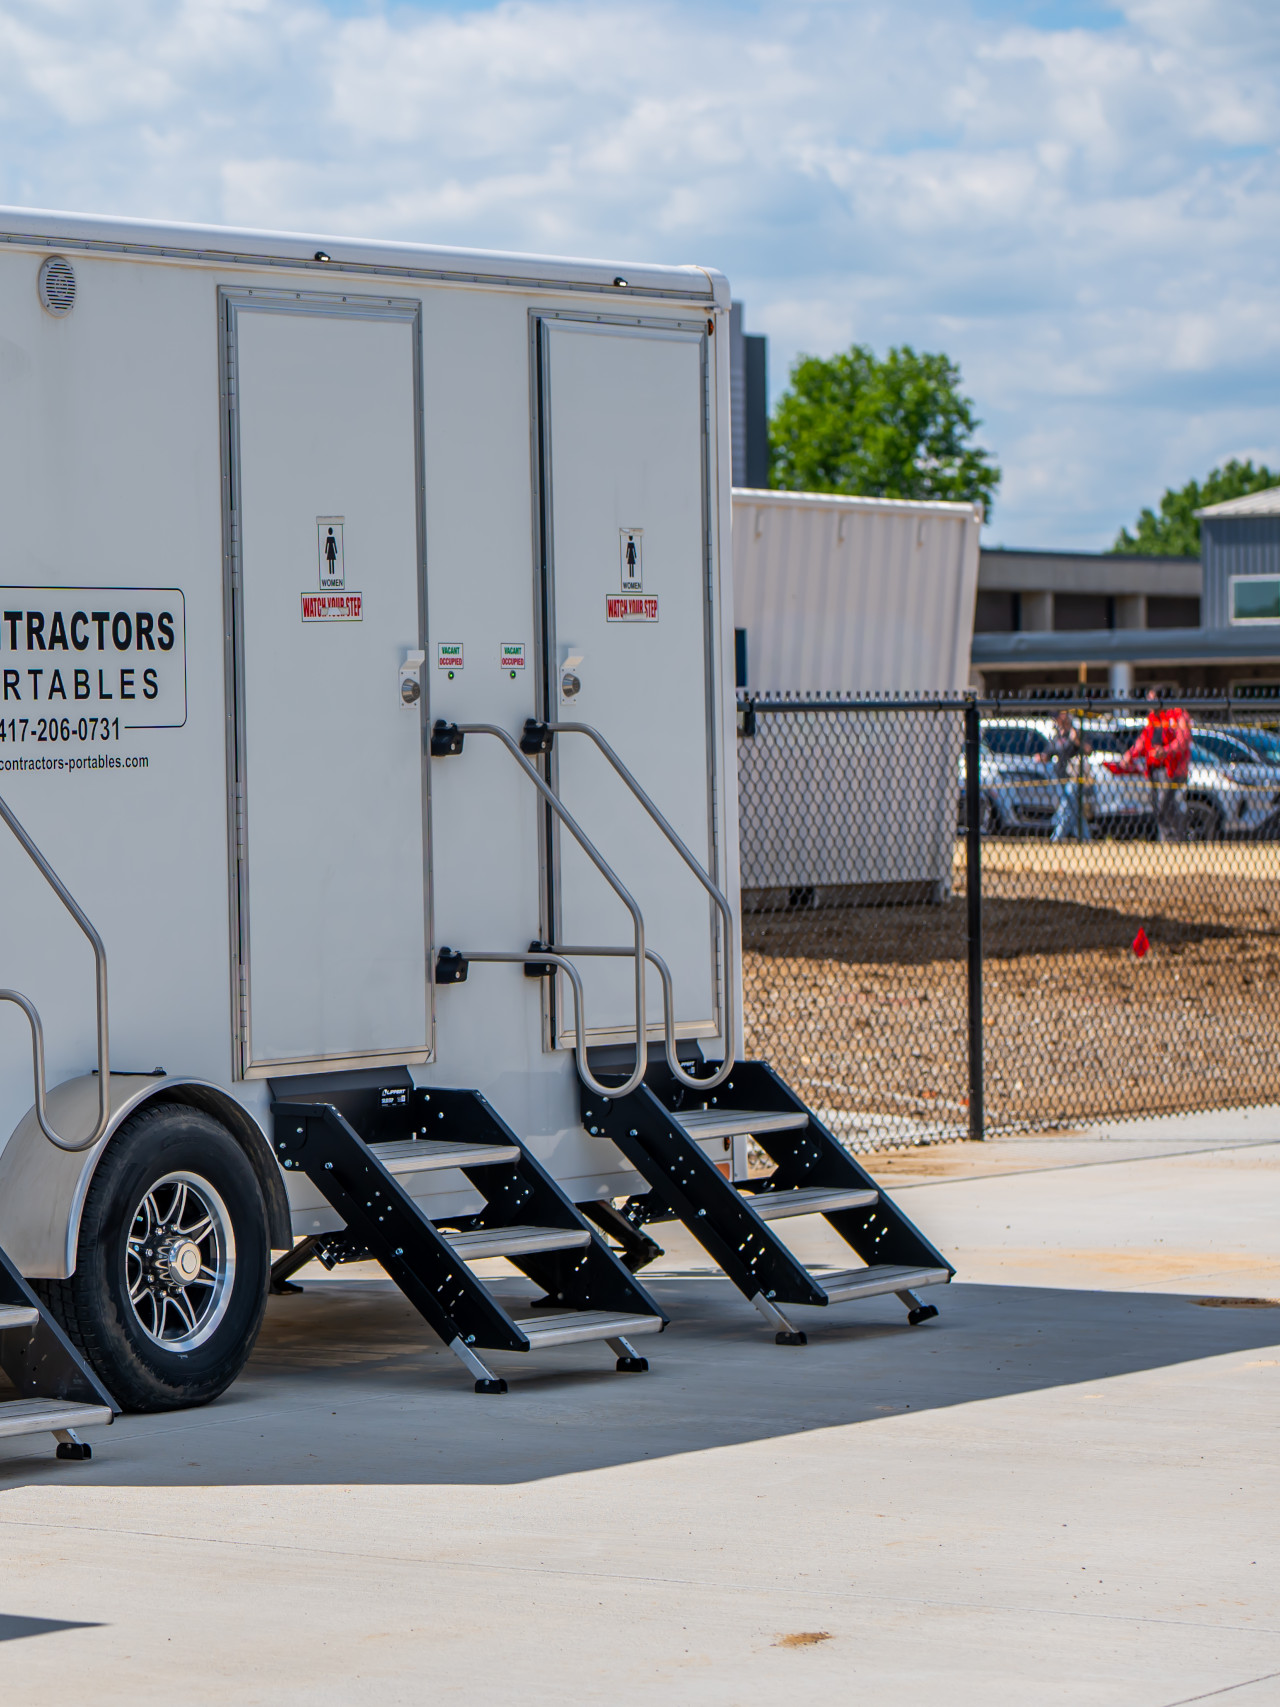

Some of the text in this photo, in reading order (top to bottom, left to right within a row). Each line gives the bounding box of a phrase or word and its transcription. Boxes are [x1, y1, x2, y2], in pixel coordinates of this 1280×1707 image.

[321, 578, 344, 587] WOMEN
[622, 581, 642, 590] WOMEN
[302, 597, 326, 617] WATCH
[346, 597, 361, 617] STEP
[608, 599, 658, 618] WATCH YOUR STEP
[441, 646, 460, 655] VACANT
[504, 646, 522, 655] VACANT
[439, 657, 463, 666] OCCUPIED
[501, 657, 524, 666] OCCUPIED
